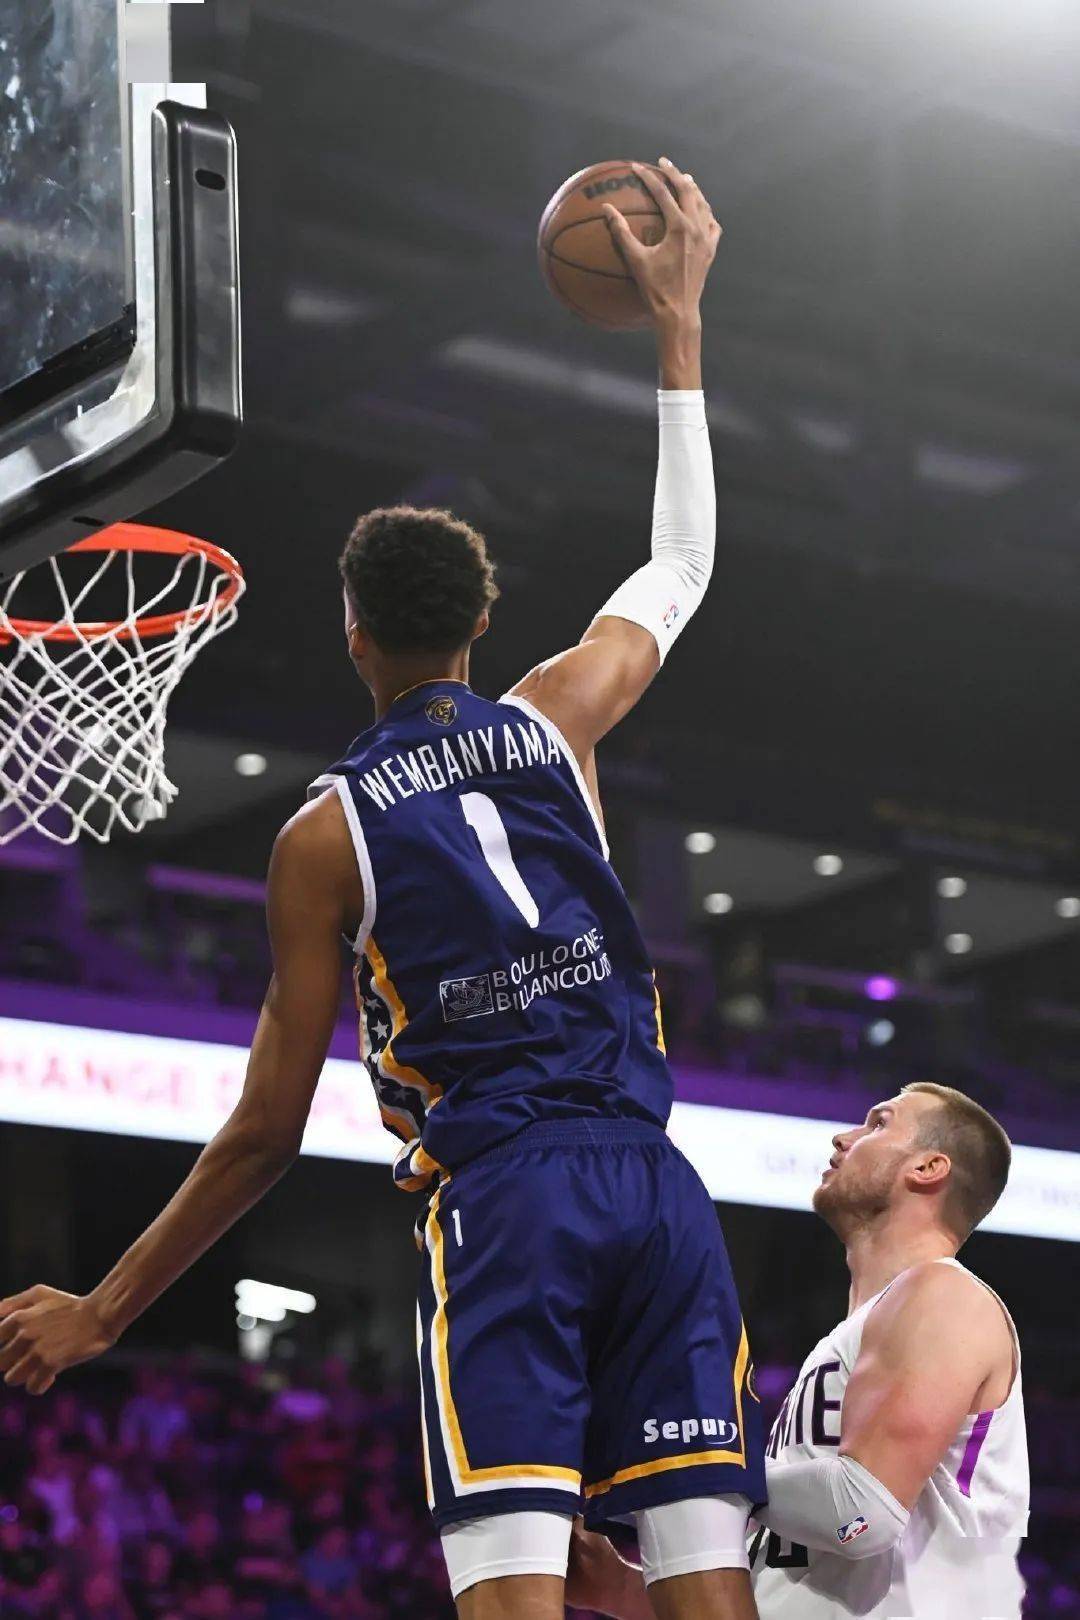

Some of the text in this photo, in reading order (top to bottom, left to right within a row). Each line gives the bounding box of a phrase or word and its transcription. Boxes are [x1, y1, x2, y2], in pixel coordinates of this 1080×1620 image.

[359, 721, 562, 812] WEMBANYAMA
[458, 791, 540, 929] 1
[452, 1208, 463, 1247] 1
[643, 1418, 727, 1443] Sepur
